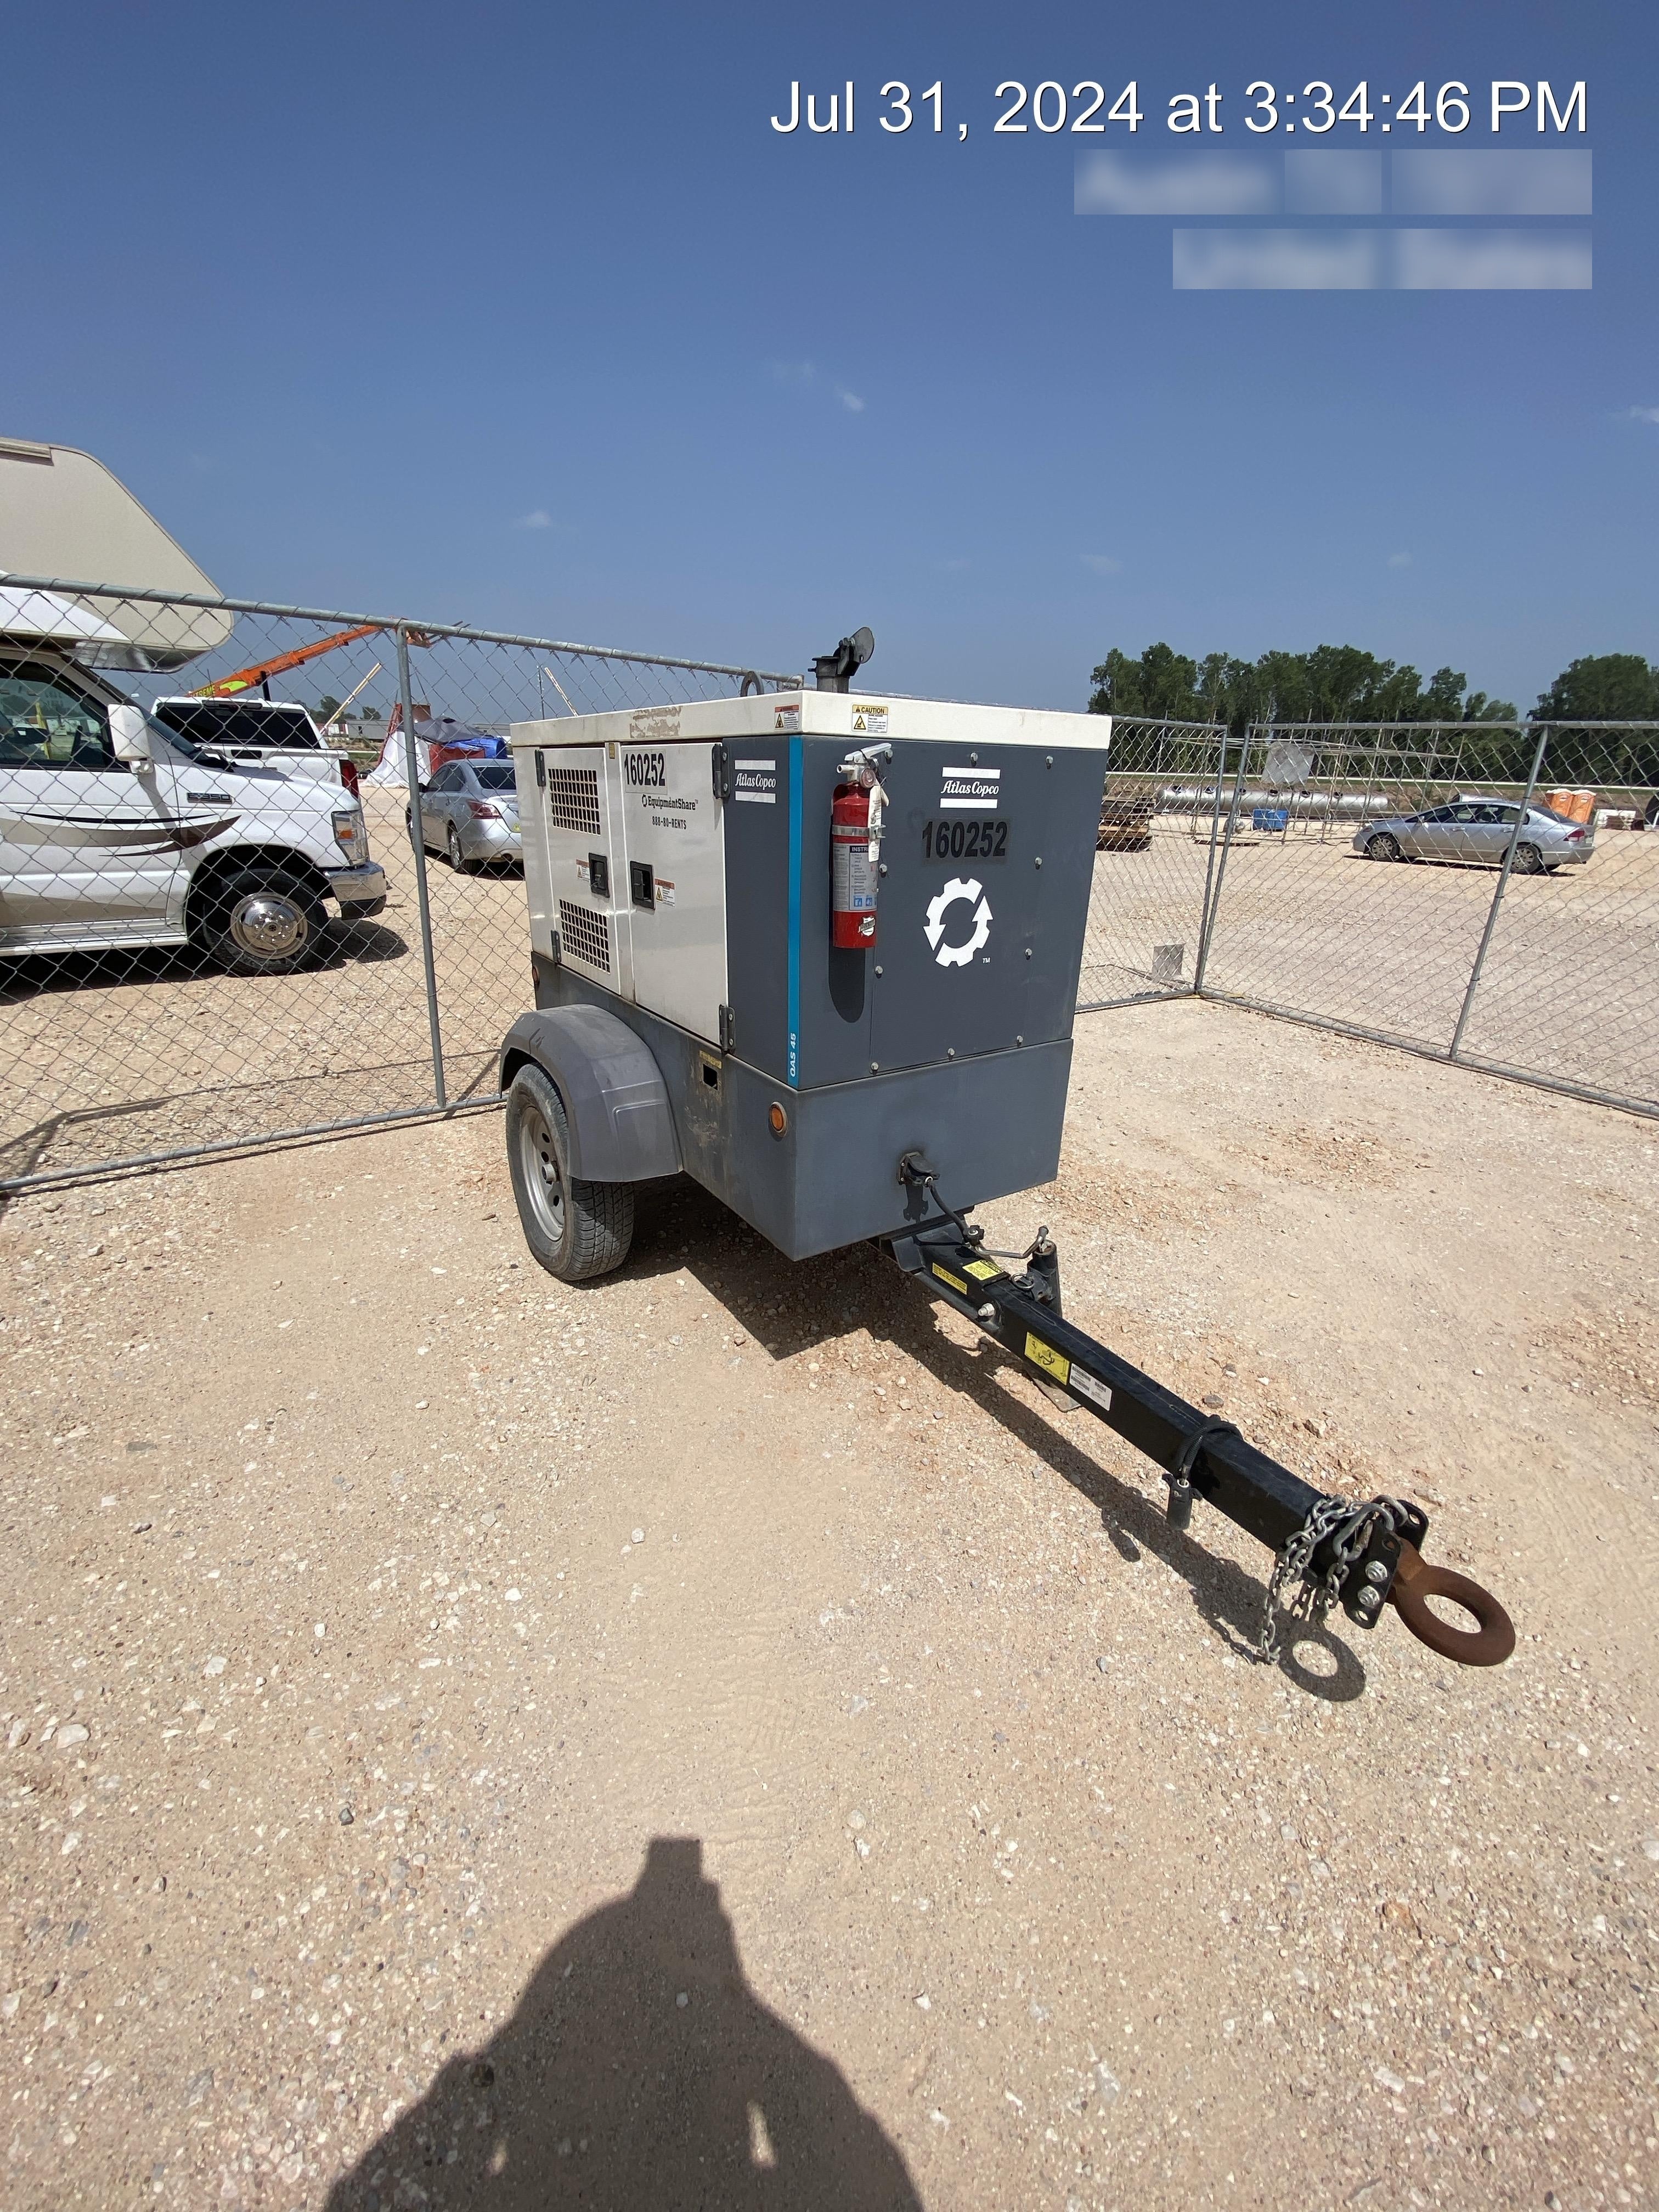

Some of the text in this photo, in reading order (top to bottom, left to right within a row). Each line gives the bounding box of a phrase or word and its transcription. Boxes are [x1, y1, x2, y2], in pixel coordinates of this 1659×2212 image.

[624, 753, 665, 786] 160252
[735, 772, 776, 790] Atlas Copco
[940, 780, 1000, 797] Atlas Copco
[647, 796, 696, 810] EquipmentShare
[922, 821, 1008, 859] 160252
